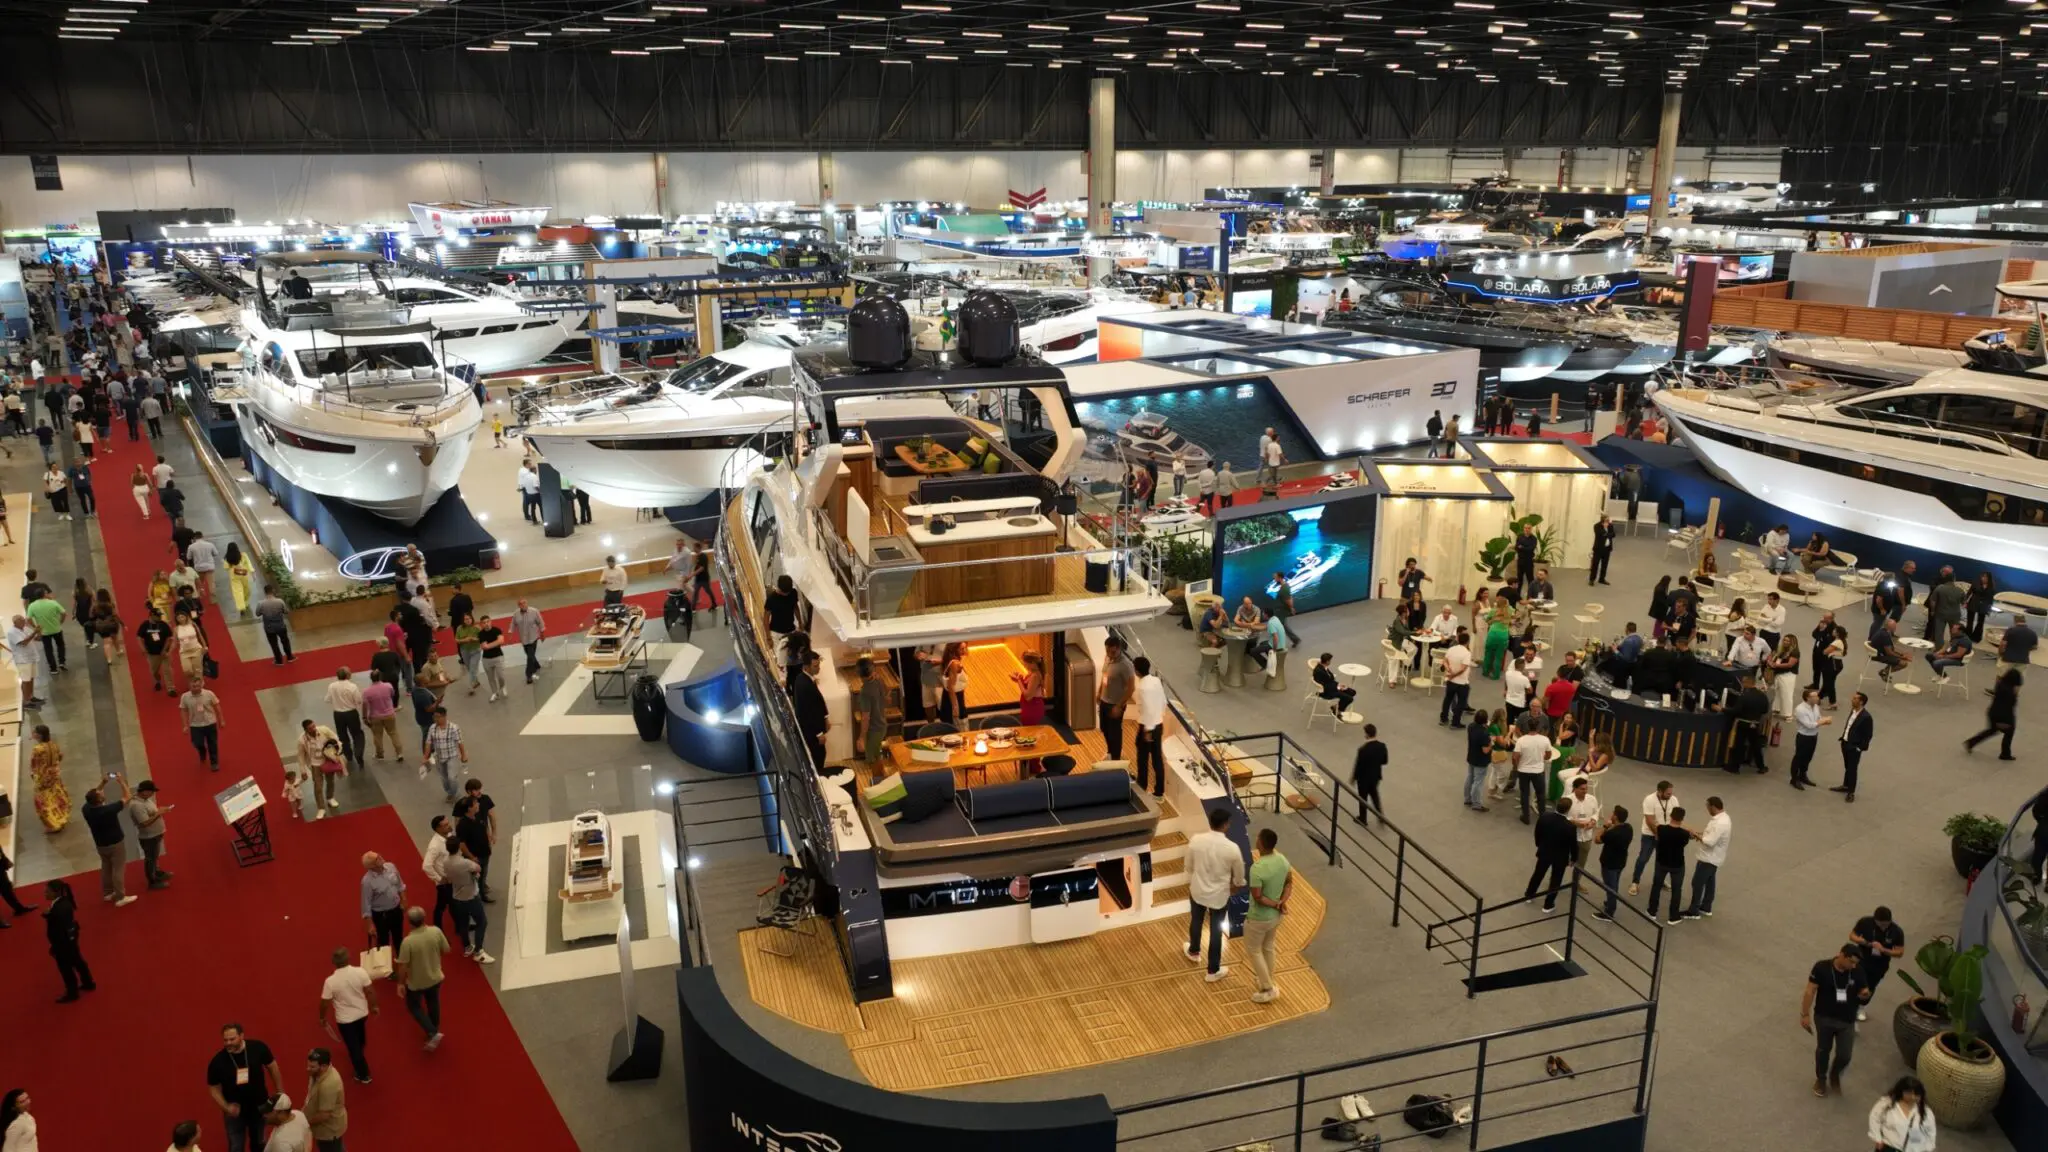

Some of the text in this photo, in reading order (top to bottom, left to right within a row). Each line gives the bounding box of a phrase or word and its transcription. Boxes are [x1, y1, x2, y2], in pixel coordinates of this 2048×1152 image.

[481, 215, 512, 225] YAMAHA
[1495, 279, 1611, 294] SOLARA SOLARA
[1347, 388, 1411, 404] SCHAEFER
[1430, 380, 1457, 397] 30
